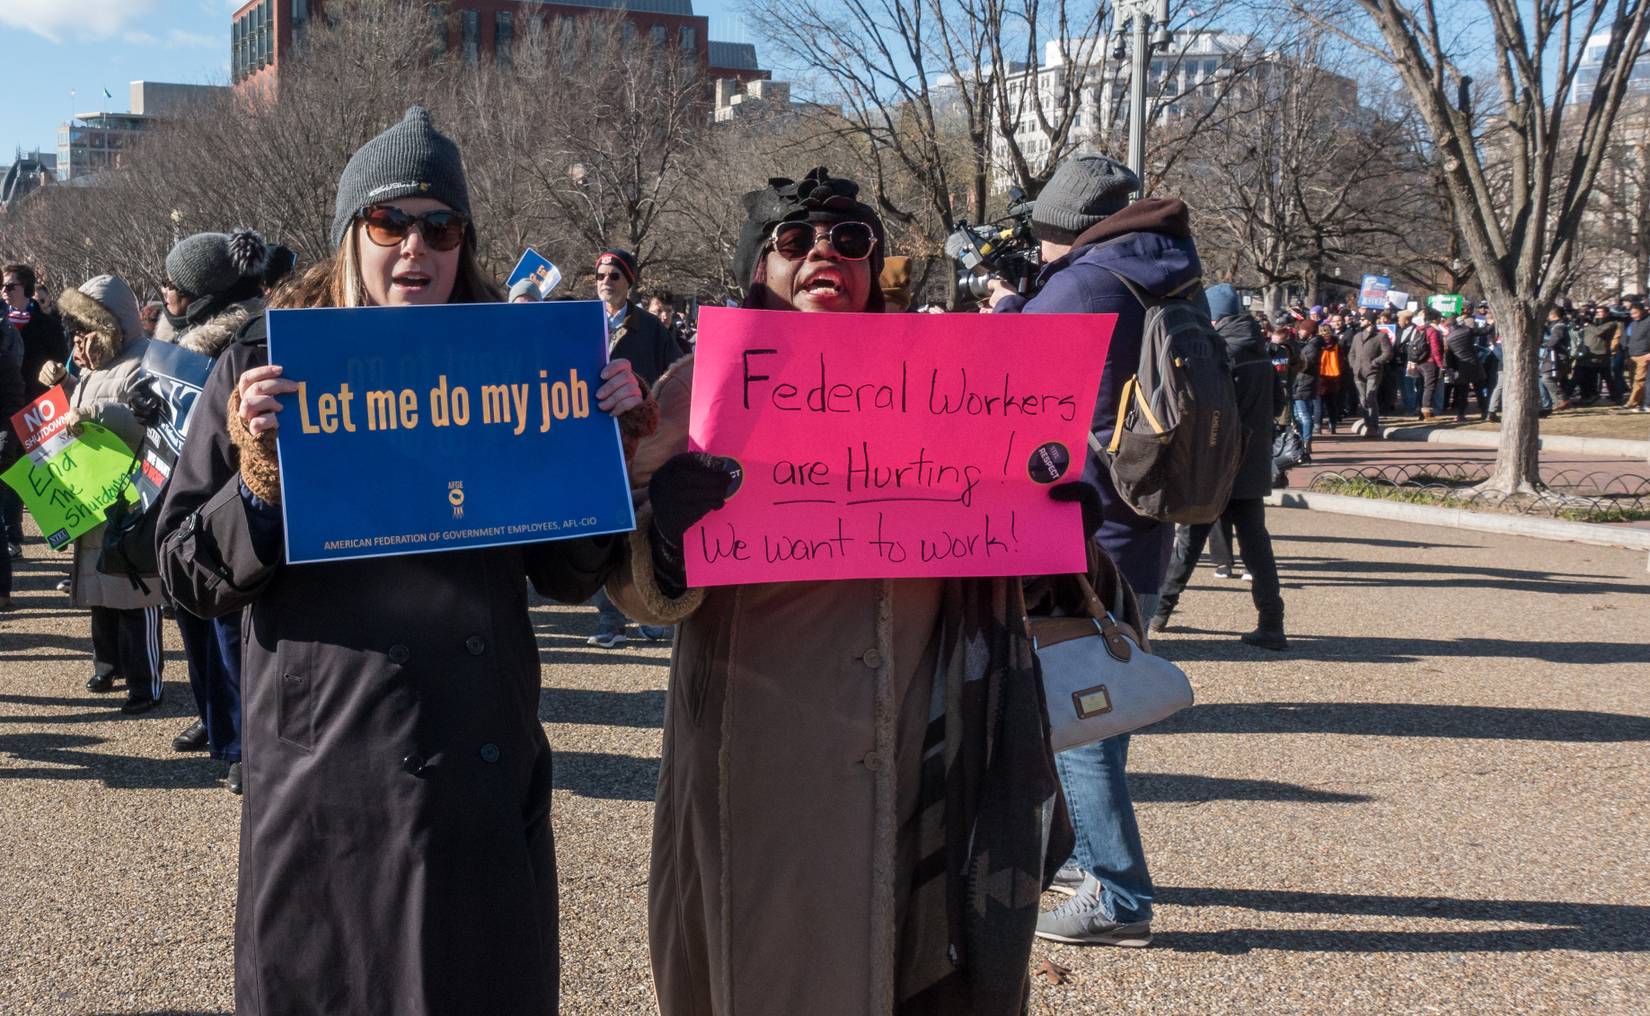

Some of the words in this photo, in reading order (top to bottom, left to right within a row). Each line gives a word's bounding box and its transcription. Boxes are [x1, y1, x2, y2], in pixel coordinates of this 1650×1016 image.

[299, 381, 356, 434] Let
[366, 388, 419, 431] me
[430, 375, 470, 427] do
[481, 383, 529, 435] my
[539, 368, 590, 433] job
[742, 348, 907, 413] Federal
[929, 367, 1077, 421] Workers
[23, 399, 56, 433] NO
[28, 452, 78, 497] End
[772, 460, 830, 487] are
[845, 441, 981, 508] Hurting
[1038, 447, 1061, 480] RESPECT
[50, 483, 84, 509] The
[324, 537, 372, 550] AMERICAN
[374, 533, 427, 546] FEDERATION
[429, 531, 441, 542] OF
[442, 526, 505, 541] GOVERNMENT
[507, 521, 561, 534] EMPLOYEES,
[562, 516, 598, 529] AFL-CIO
[700, 523, 750, 564] We
[764, 517, 855, 564] want
[868, 512, 907, 563] to
[920, 510, 1019, 562] work!
